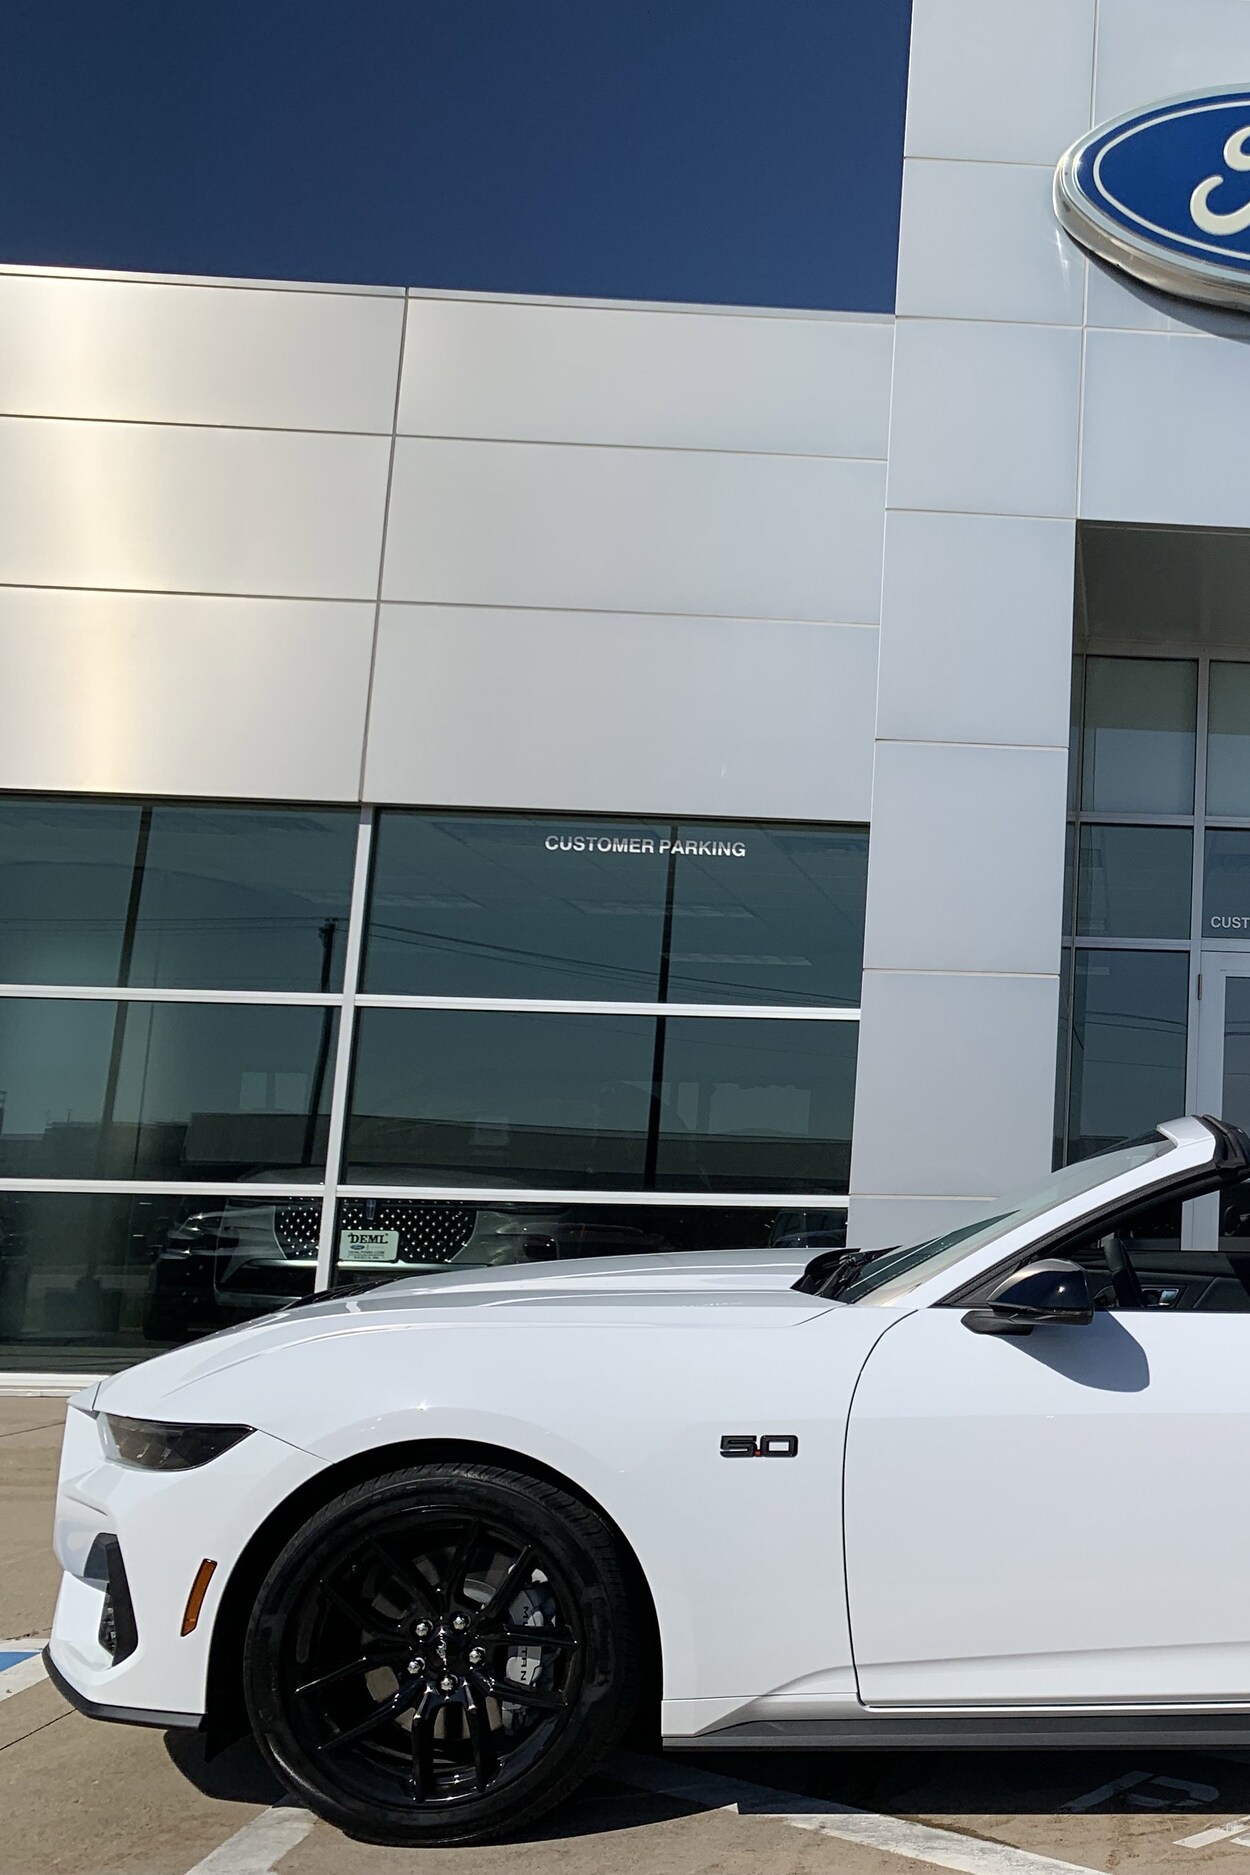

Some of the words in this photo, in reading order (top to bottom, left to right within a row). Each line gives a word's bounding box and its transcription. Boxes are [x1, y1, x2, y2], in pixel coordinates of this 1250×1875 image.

[544, 835, 654, 854] CUSTOMER
[658, 839, 746, 857] PARKING
[347, 1232, 388, 1244] DEML
[720, 1434, 798, 1458] 5.0
